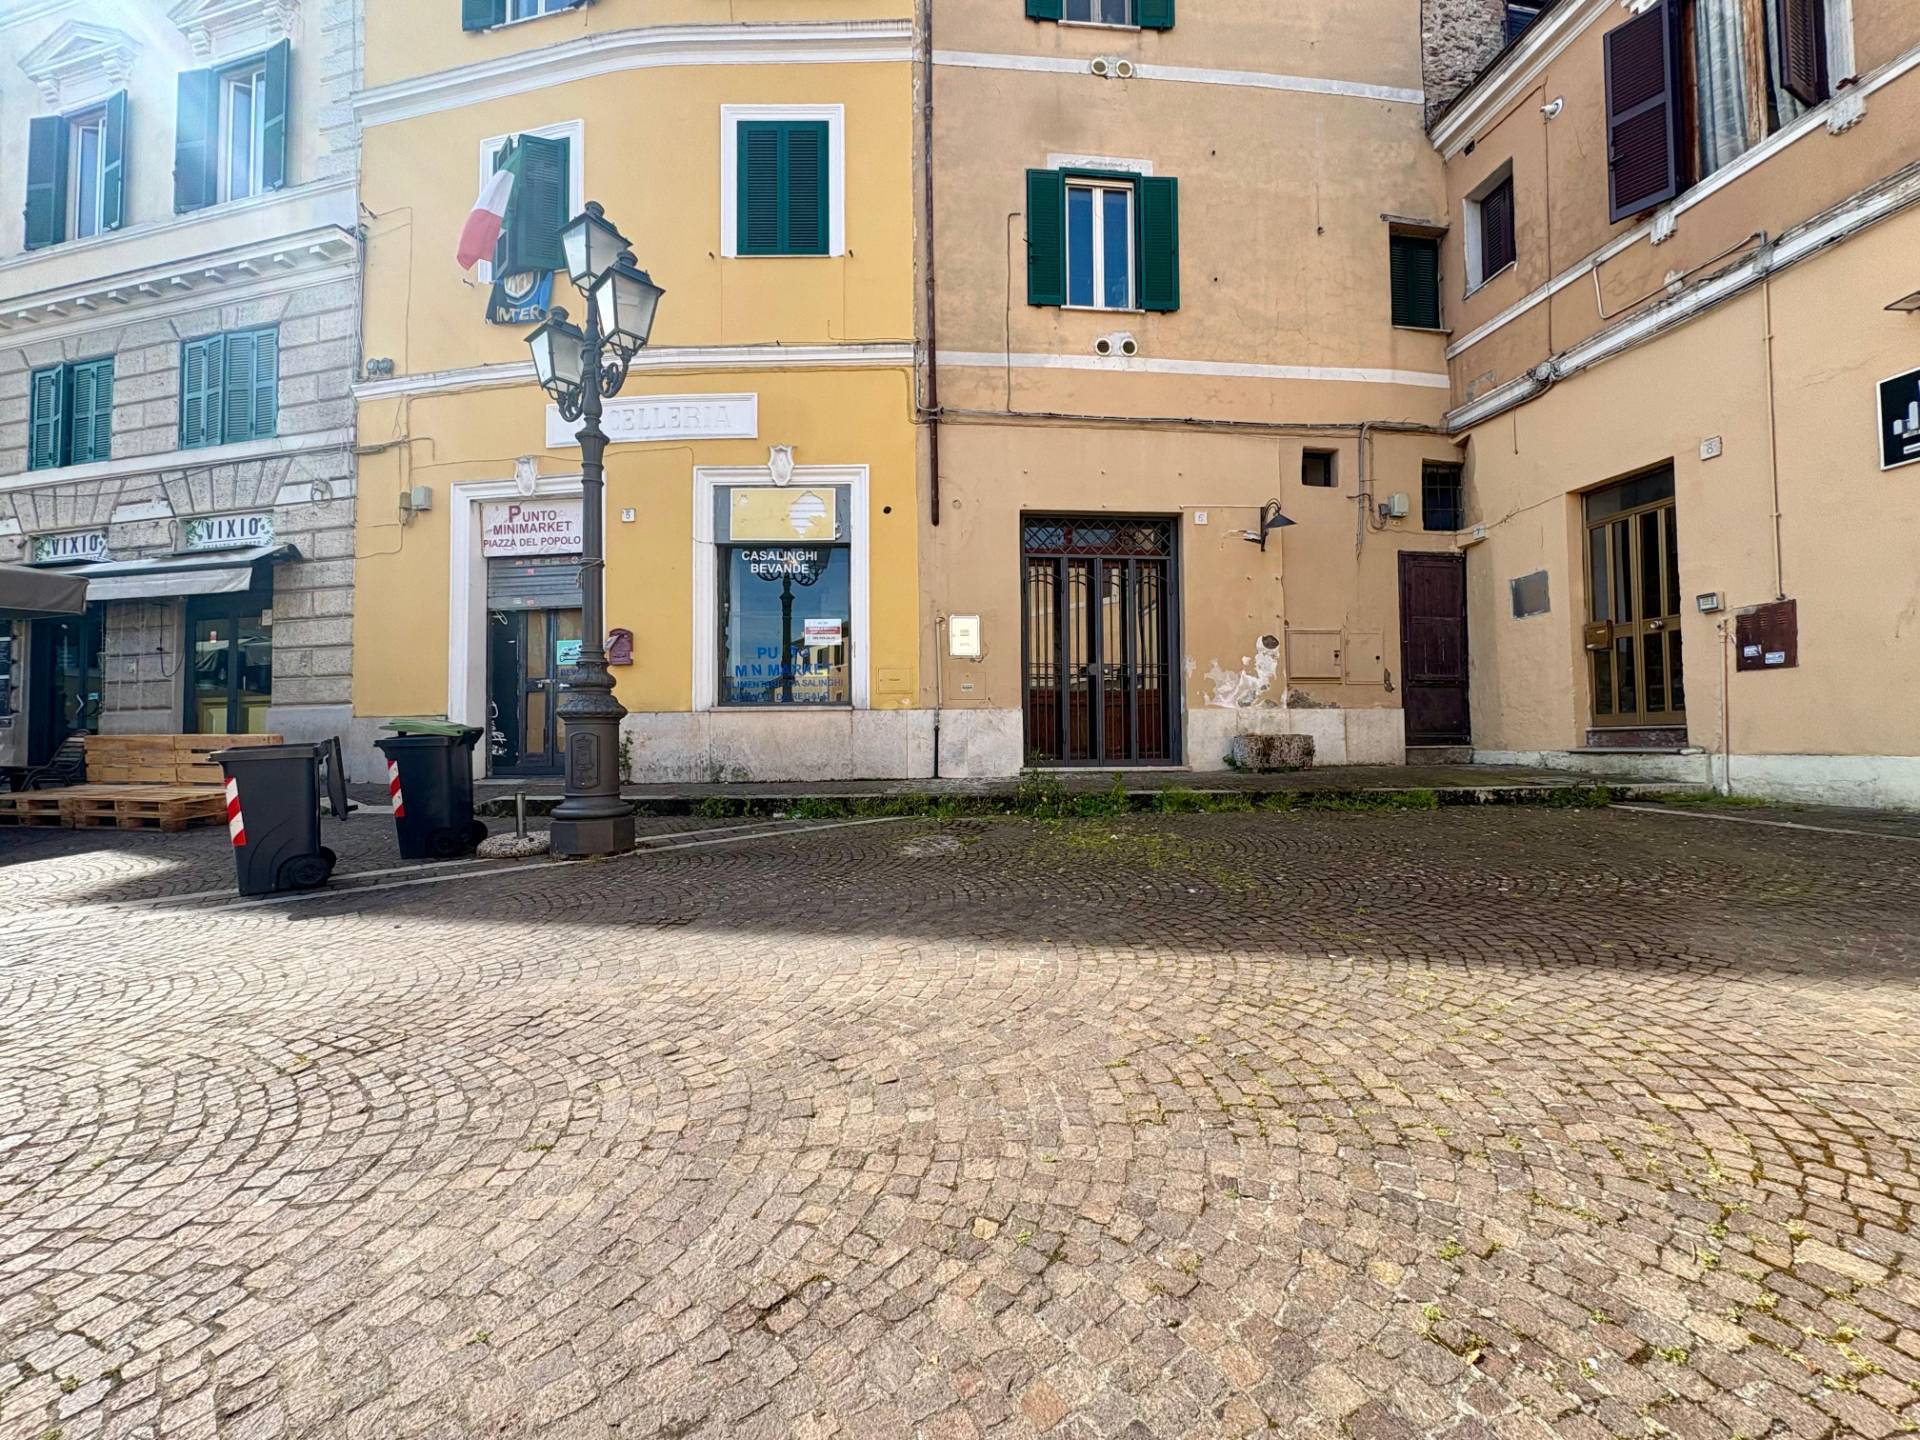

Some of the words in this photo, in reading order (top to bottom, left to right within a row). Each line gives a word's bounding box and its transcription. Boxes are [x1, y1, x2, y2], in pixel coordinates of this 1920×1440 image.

[496, 304, 542, 323] INTER
[606, 404, 732, 432] CELLERIA
[508, 504, 557, 523] PUNTO
[206, 516, 260, 541] VIXIO
[493, 521, 572, 536] MINIMARKET
[51, 534, 99, 556] VIXIO
[483, 538, 517, 549] PIAZZA
[519, 537, 538, 547] DEL
[540, 535, 582, 546] POPOLO
[741, 550, 818, 561] CASALINGHI
[750, 563, 809, 574] BEVANDE
